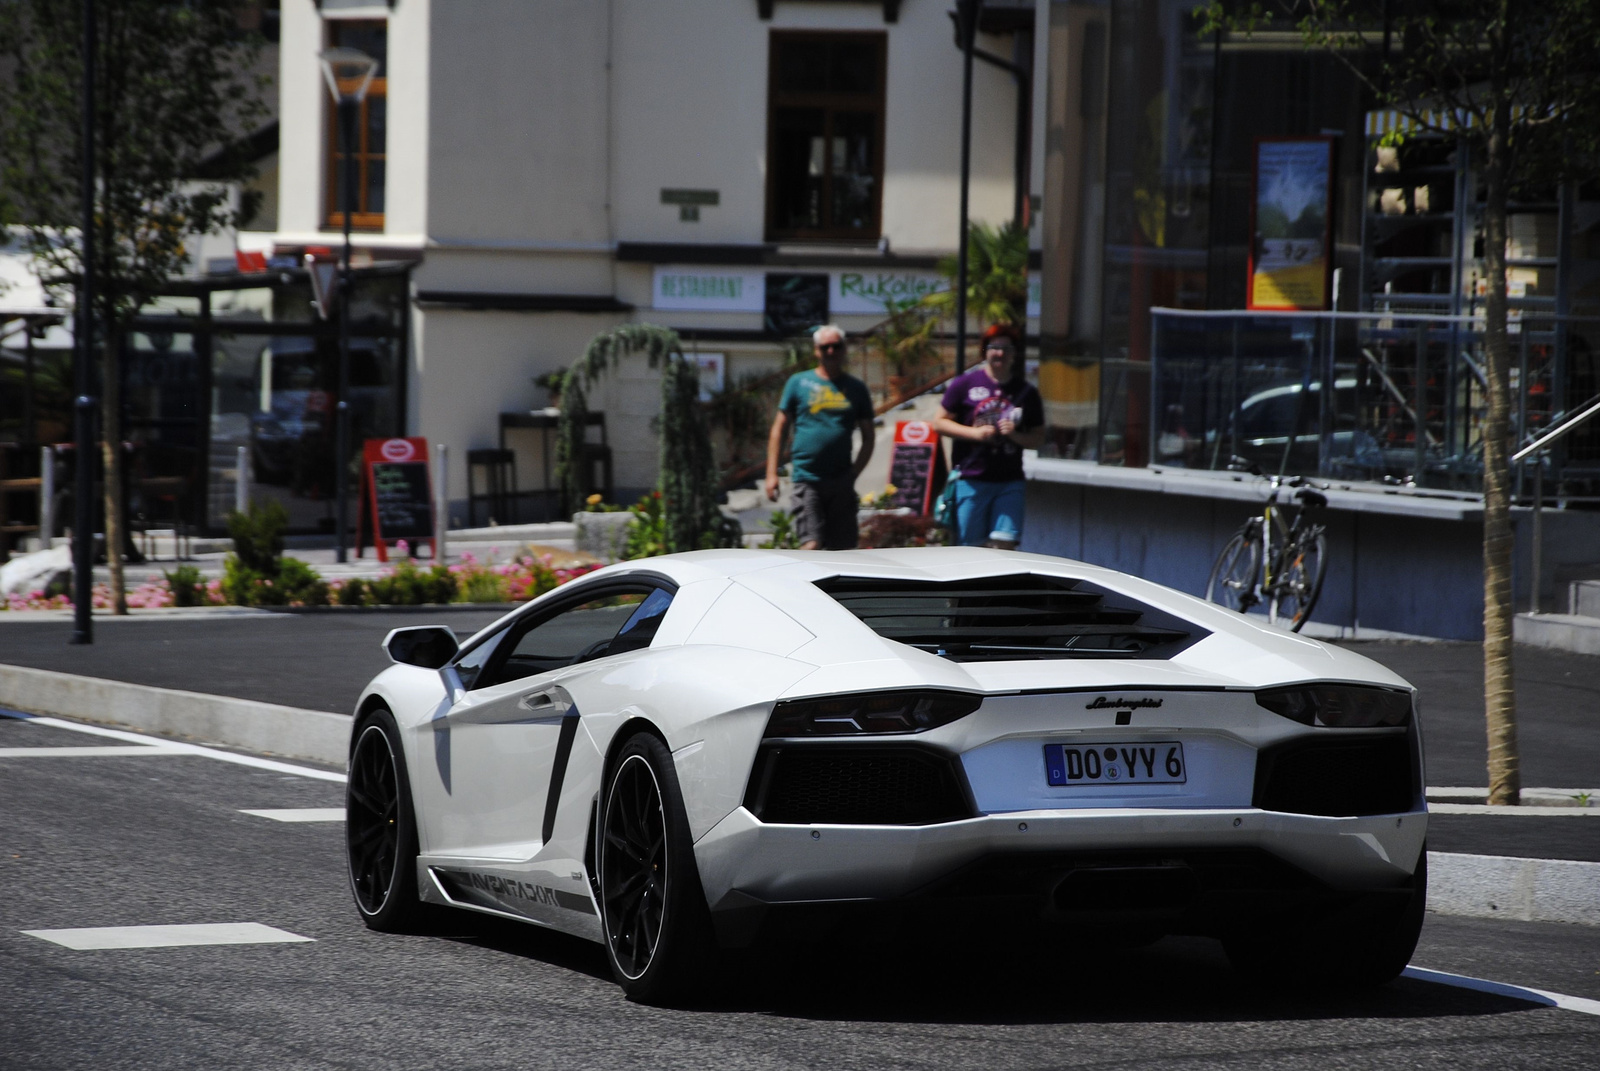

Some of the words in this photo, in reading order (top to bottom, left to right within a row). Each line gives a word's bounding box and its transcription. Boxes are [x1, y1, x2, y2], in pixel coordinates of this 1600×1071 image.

[661, 275, 743, 298] RESTAURANT
[1085, 696, 1164, 710] Lamborghini
[1053, 769, 1060, 779] D
[1065, 749, 1102, 780] DO
[1120, 747, 1155, 778] YY
[1165, 747, 1182, 778] 6
[472, 873, 559, 906] AVENTADOR
